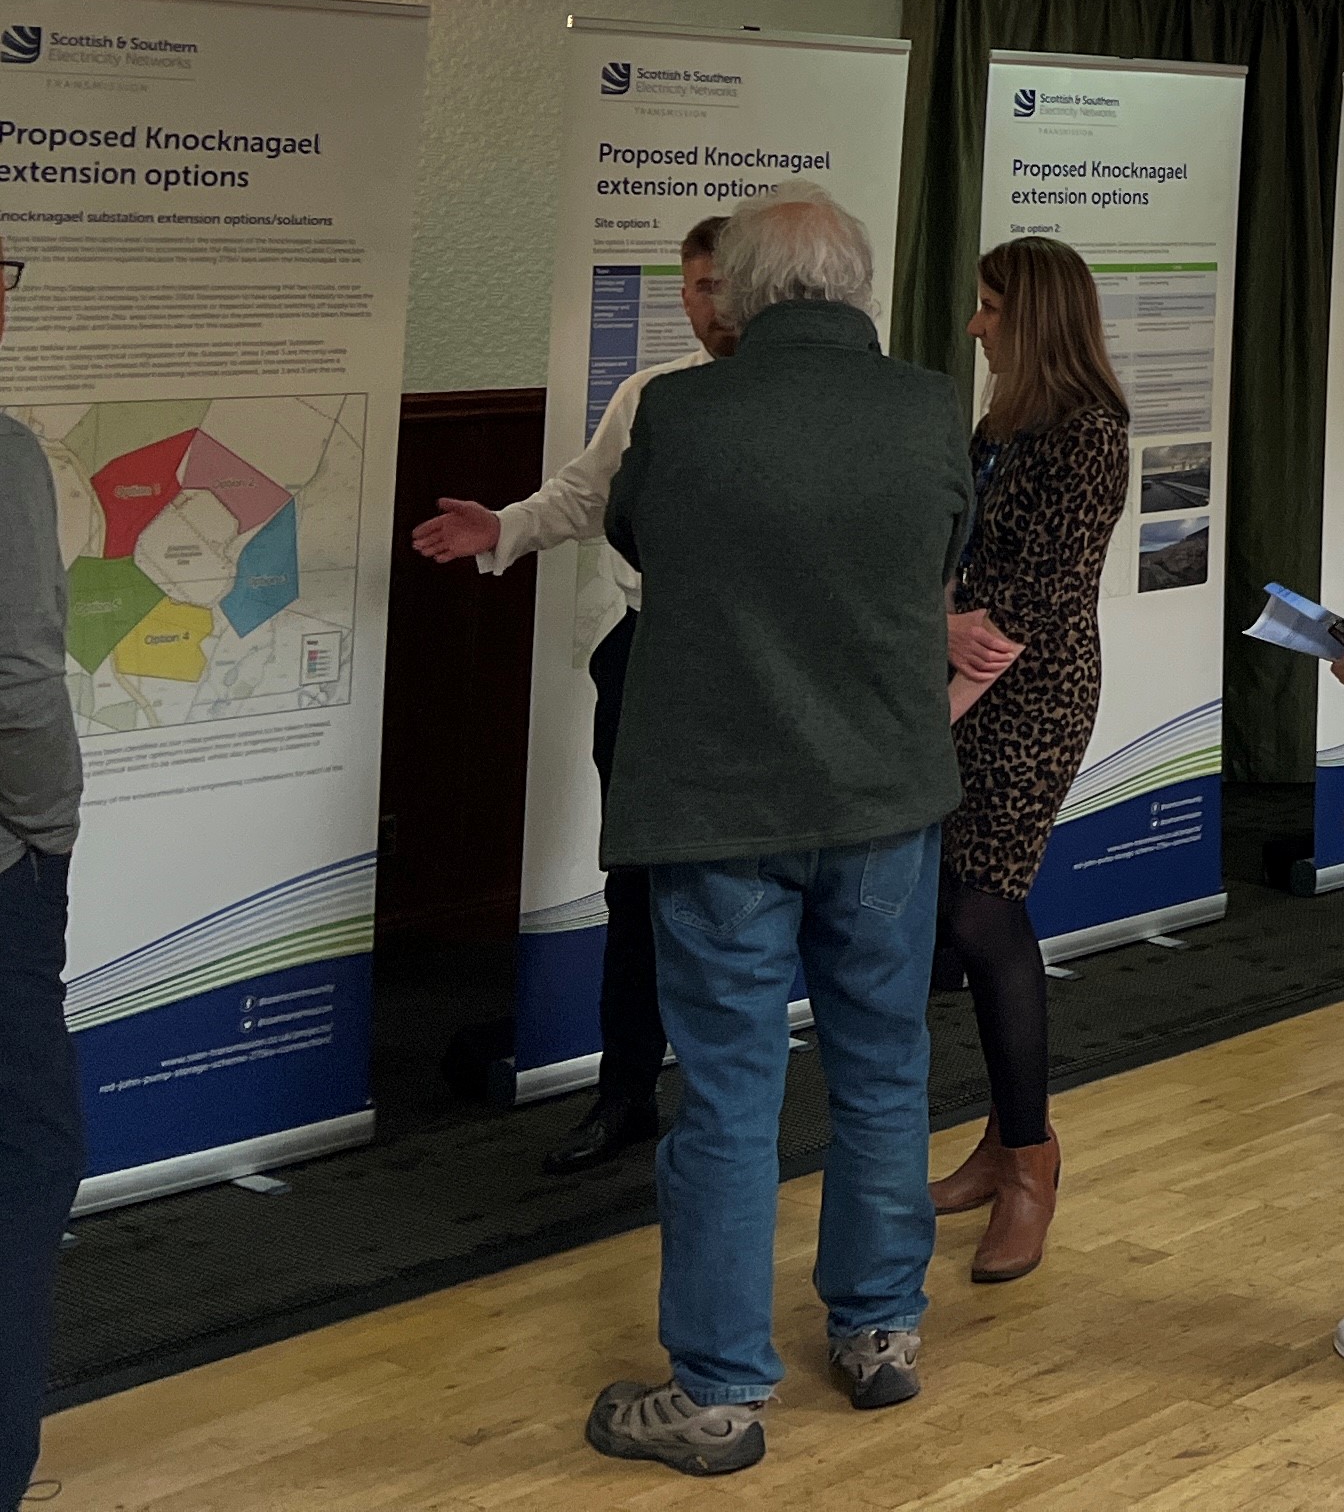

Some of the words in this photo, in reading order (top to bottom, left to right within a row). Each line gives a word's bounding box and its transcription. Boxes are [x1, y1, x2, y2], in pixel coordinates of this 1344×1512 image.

[50, 32, 113, 49] Scottish
[117, 38, 128, 49] &
[131, 38, 198, 53] Southern
[48, 49, 122, 68] Electricity
[126, 53, 191, 69] Networks
[637, 68, 681, 81] Scottish
[683, 71, 690, 81] &
[693, 71, 742, 85] Southern
[636, 83, 687, 97] Electricity
[690, 85, 738, 97] Networks
[1040, 94, 1074, 104] Scottish
[1075, 96, 1080, 104] &
[1083, 96, 1119, 106] Southern
[0, 121, 136, 151] Proposed
[146, 127, 321, 158] Knocknagael
[599, 143, 698, 168] Proposed
[705, 147, 830, 173] Knocknagael
[0, 162, 135, 185] extension
[144, 165, 249, 191] options
[1013, 159, 1086, 181] Proposed
[1092, 161, 1187, 183] Knocknagael
[597, 177, 698, 197] extension
[704, 179, 778, 201] options
[1012, 188, 1086, 204] extension
[1092, 188, 1148, 208] options
[87, 211, 155, 224] substation
[157, 212, 220, 225] extension
[223, 213, 333, 227] options/solutions
[594, 218, 614, 228] Site
[617, 219, 650, 231] option
[1010, 224, 1025, 232] Site
[1028, 224, 1053, 234] option
